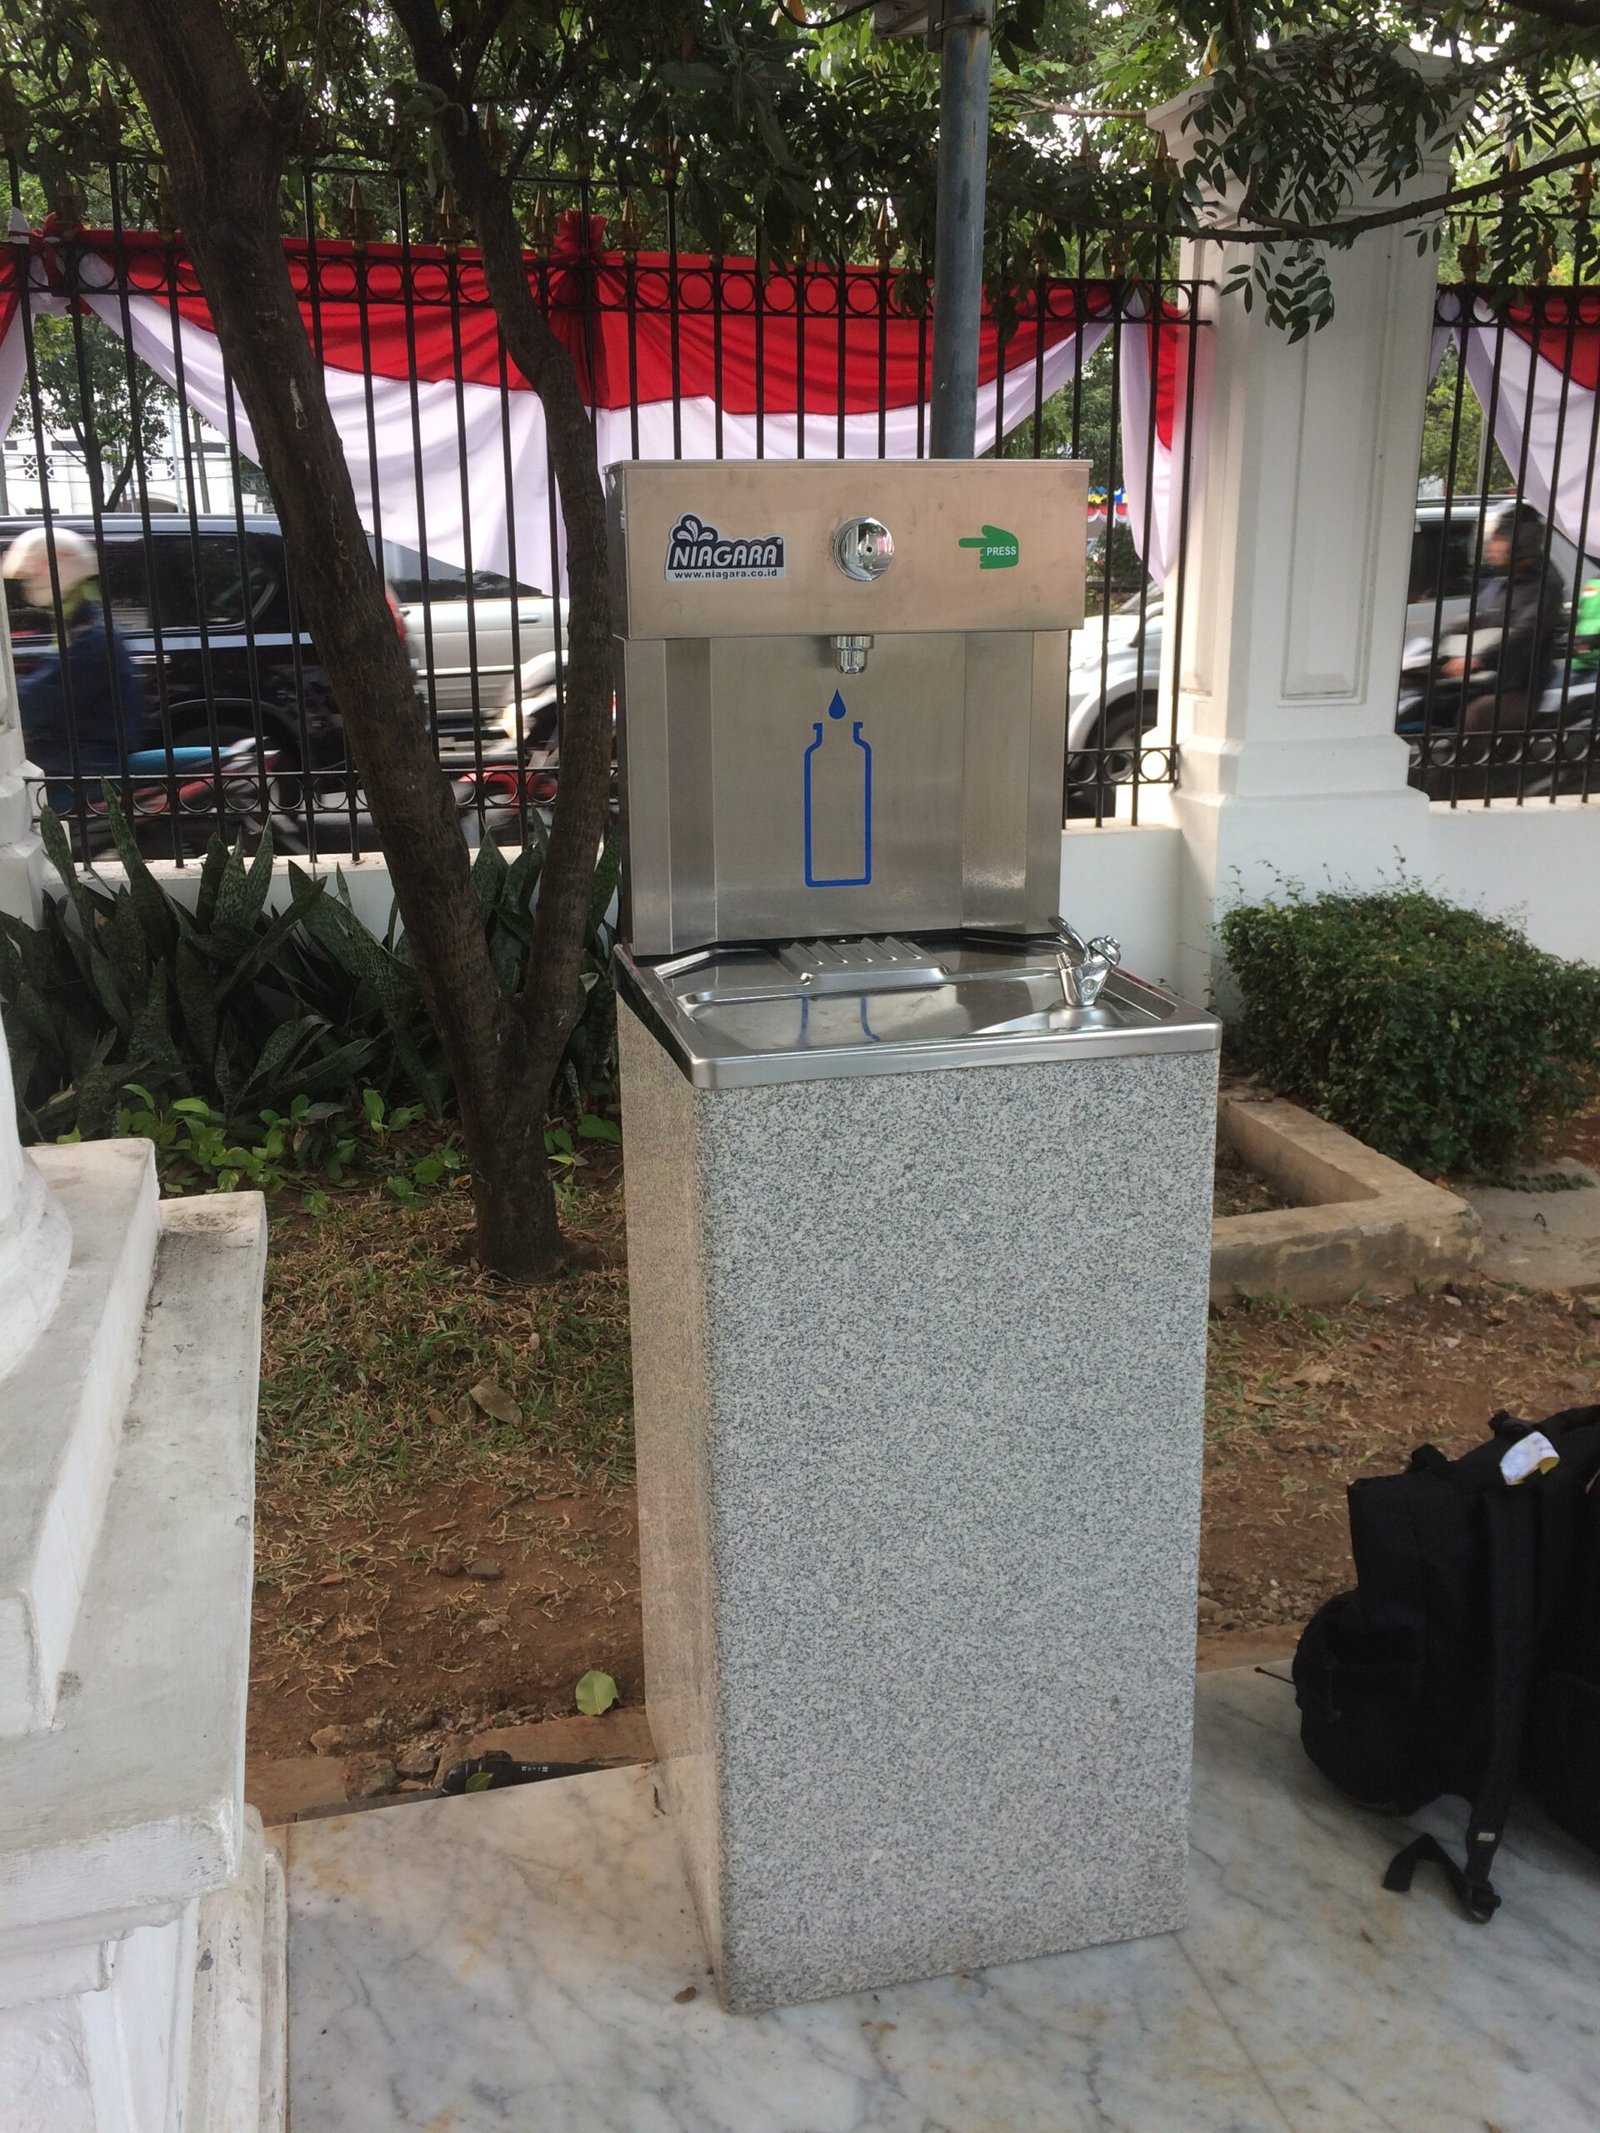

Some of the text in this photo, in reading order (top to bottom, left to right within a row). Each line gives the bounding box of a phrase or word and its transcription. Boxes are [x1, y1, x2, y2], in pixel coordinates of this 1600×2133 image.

[673, 545, 777, 567] NIAGARA
[986, 546, 1017, 556] PRESS
[674, 569, 778, 579] www.niagara.co.id
